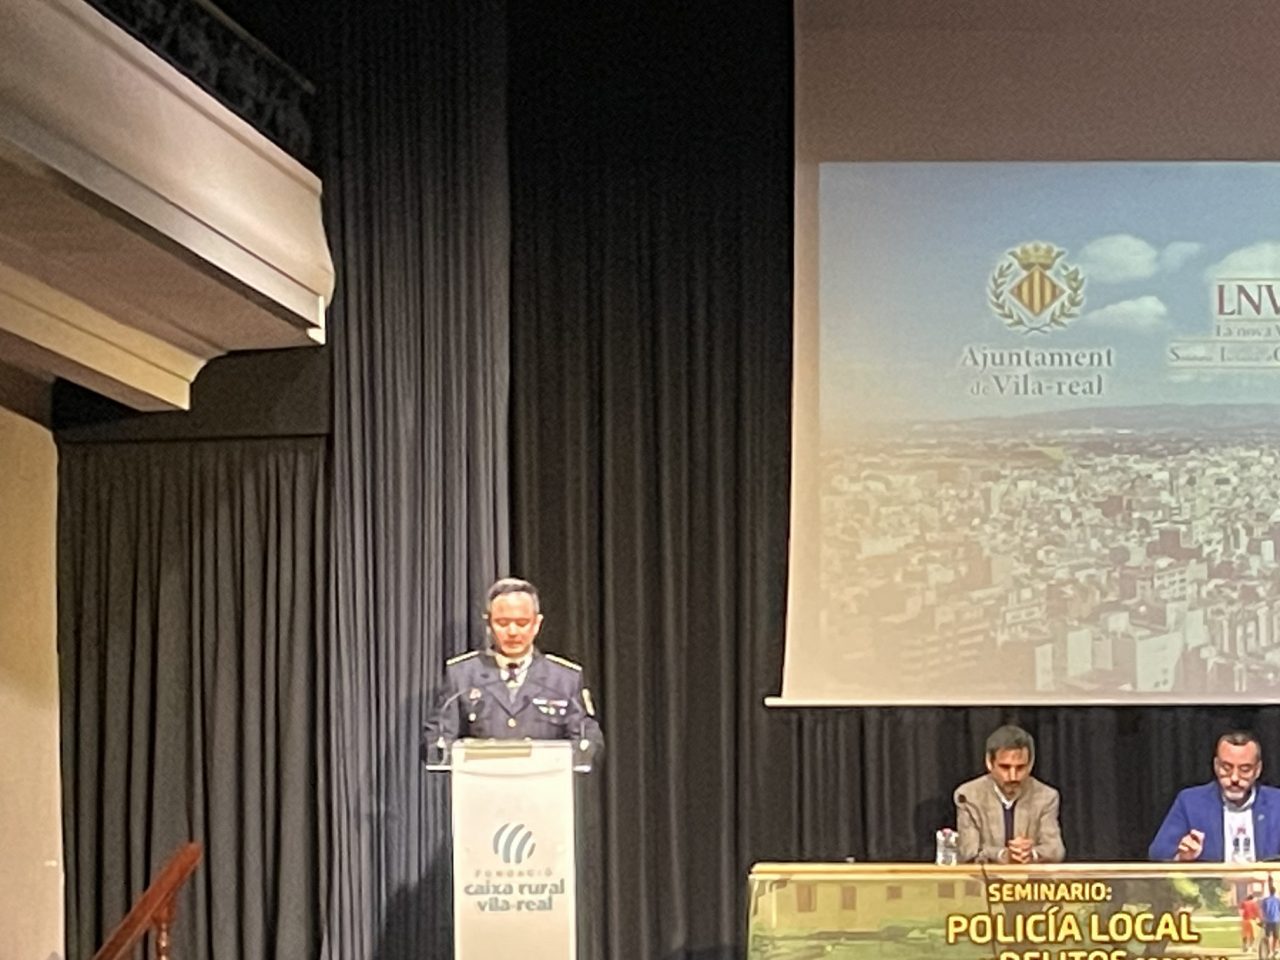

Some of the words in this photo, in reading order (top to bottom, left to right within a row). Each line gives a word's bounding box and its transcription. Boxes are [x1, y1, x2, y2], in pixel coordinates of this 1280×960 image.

[962, 346, 1113, 373] Ajuntament
[993, 374, 1103, 396] Vila-real
[464, 879, 514, 896] caixa
[518, 877, 566, 895] rural
[988, 882, 1113, 902] SEMINARIO:
[946, 906, 1083, 944] POLICÍA
[1090, 912, 1200, 942] LOCAL
